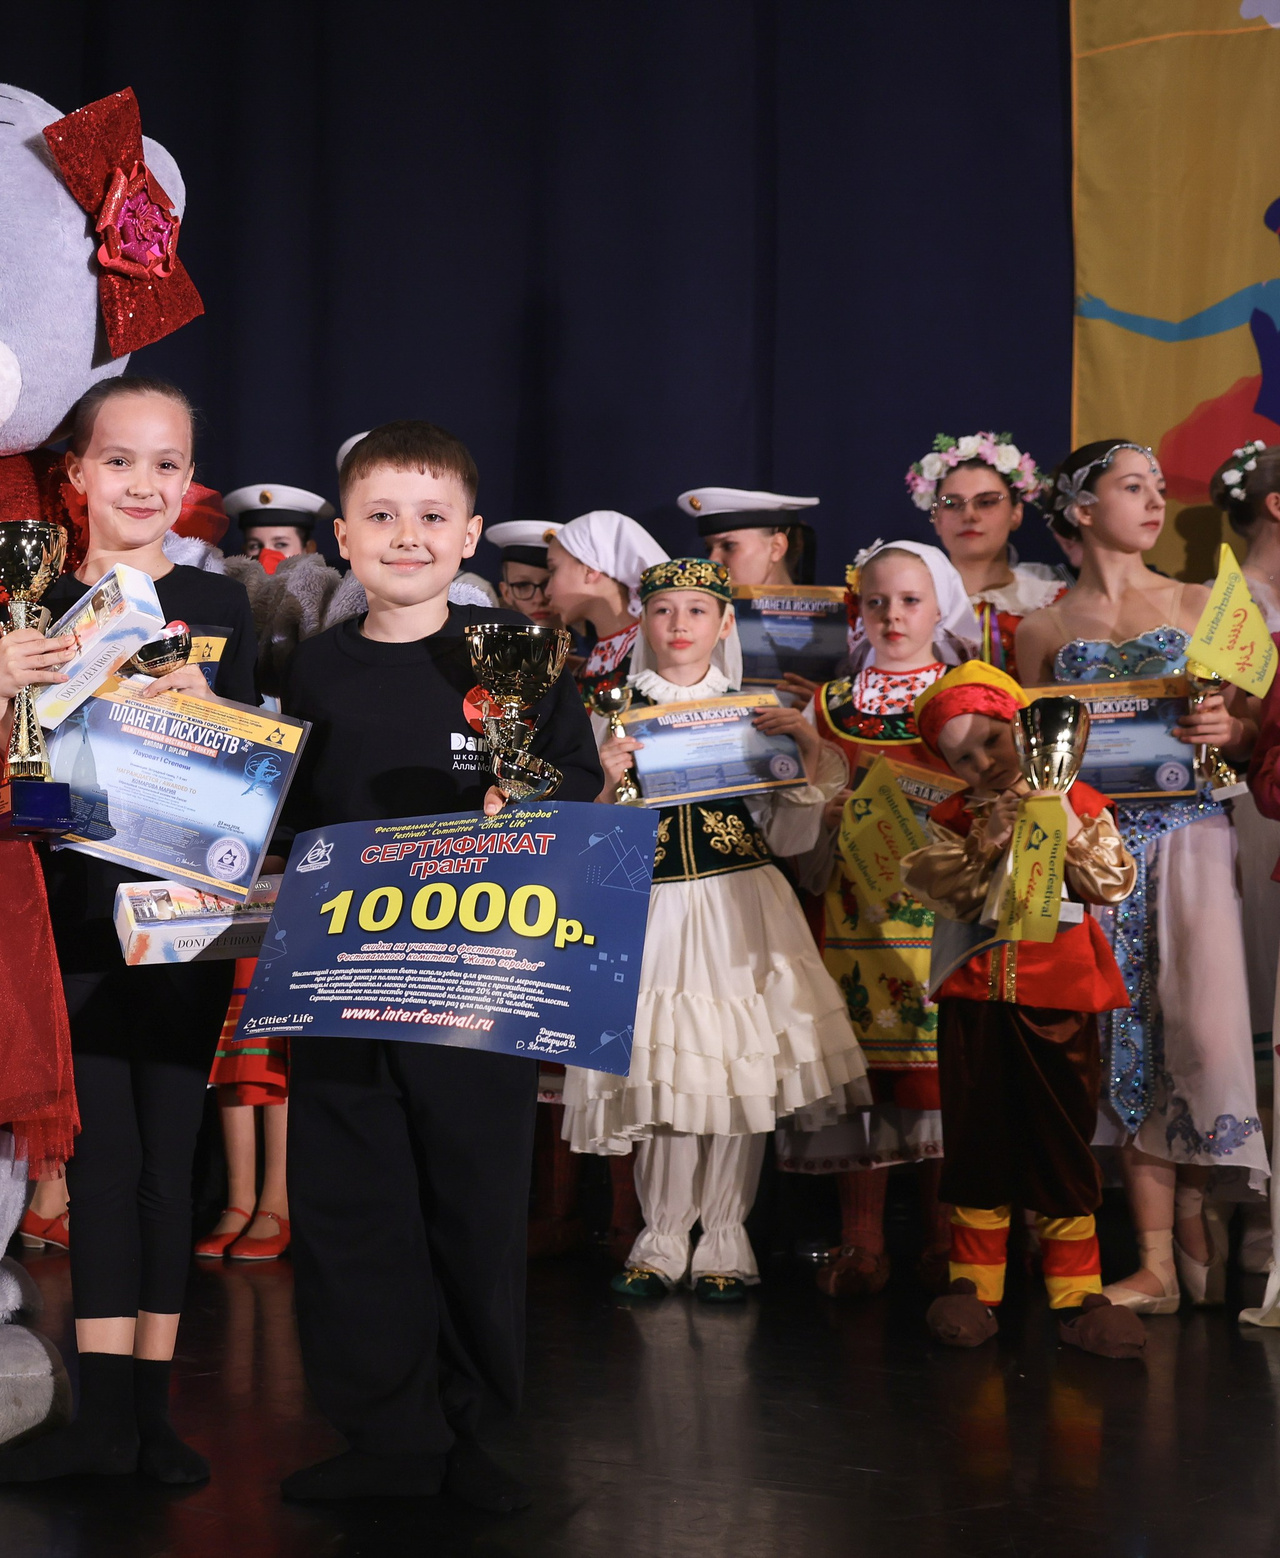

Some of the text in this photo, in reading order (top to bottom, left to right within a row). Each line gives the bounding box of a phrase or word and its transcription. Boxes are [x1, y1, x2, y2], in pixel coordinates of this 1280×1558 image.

[61, 679, 85, 699] DONI
[82, 643, 121, 681] ZEFIRONI
[657, 711, 700, 727] ПЛАНЕТА
[700, 706, 749, 722] ИСКУССТВ
[1092, 698, 1150, 714] ИСКУССТВ
[109, 703, 166, 735] ПЛАНЕТА
[168, 719, 241, 755] ИСКУССТВ
[450, 732, 488, 752] Dan
[452, 761, 477, 771] Аллы
[453, 754, 485, 762] школа
[897, 778, 930, 800] ЛАНЕТА
[375, 820, 436, 834] Фестивальный
[437, 817, 478, 829] комитет
[879, 784, 920, 851] @interfestiva
[393, 828, 431, 840] Festivals'
[434, 825, 474, 836] Committee
[360, 832, 556, 865] СЕРТИФИКАТ
[409, 857, 489, 880] грант
[178, 938, 206, 949] DONI
[360, 940, 517, 958] скидка на участие в фестивалях
[337, 952, 406, 962] Фестивального
[406, 953, 458, 963] комитета
[292, 969, 329, 977] Настоящий
[329, 968, 372, 977] сертификат
[419, 969, 461, 978] использован
[478, 973, 509, 982] участия
[515, 977, 572, 992] мероприятиях,
[327, 974, 353, 982] условии
[405, 975, 459, 985] фестивального
[460, 979, 487, 988] пакета
[492, 983, 545, 995] проживанием.
[289, 982, 329, 990] Настоящим
[329, 981, 381, 989] сертификатом
[408, 983, 445, 991] оплатить
[455, 986, 475, 994] более
[476, 987, 490, 995] 20%
[503, 991, 524, 1000] общей
[525, 994, 570, 1007] стоимости.
[363, 988, 404, 996] количество
[404, 990, 446, 999] участников
[447, 993, 491, 1003] коллектива
[496, 997, 504, 1005] 15
[505, 999, 535, 1009] человек.
[309, 994, 353, 1003] Сертификат
[378, 995, 427, 1005] использовать
[446, 1001, 459, 1009] раз
[474, 1003, 513, 1013] получения
[513, 1008, 540, 1019] скидки.
[258, 1013, 314, 1026] Cities' Life
[340, 1005, 495, 1032] www.interfestival.ru
[539, 1027, 575, 1040] Директор
